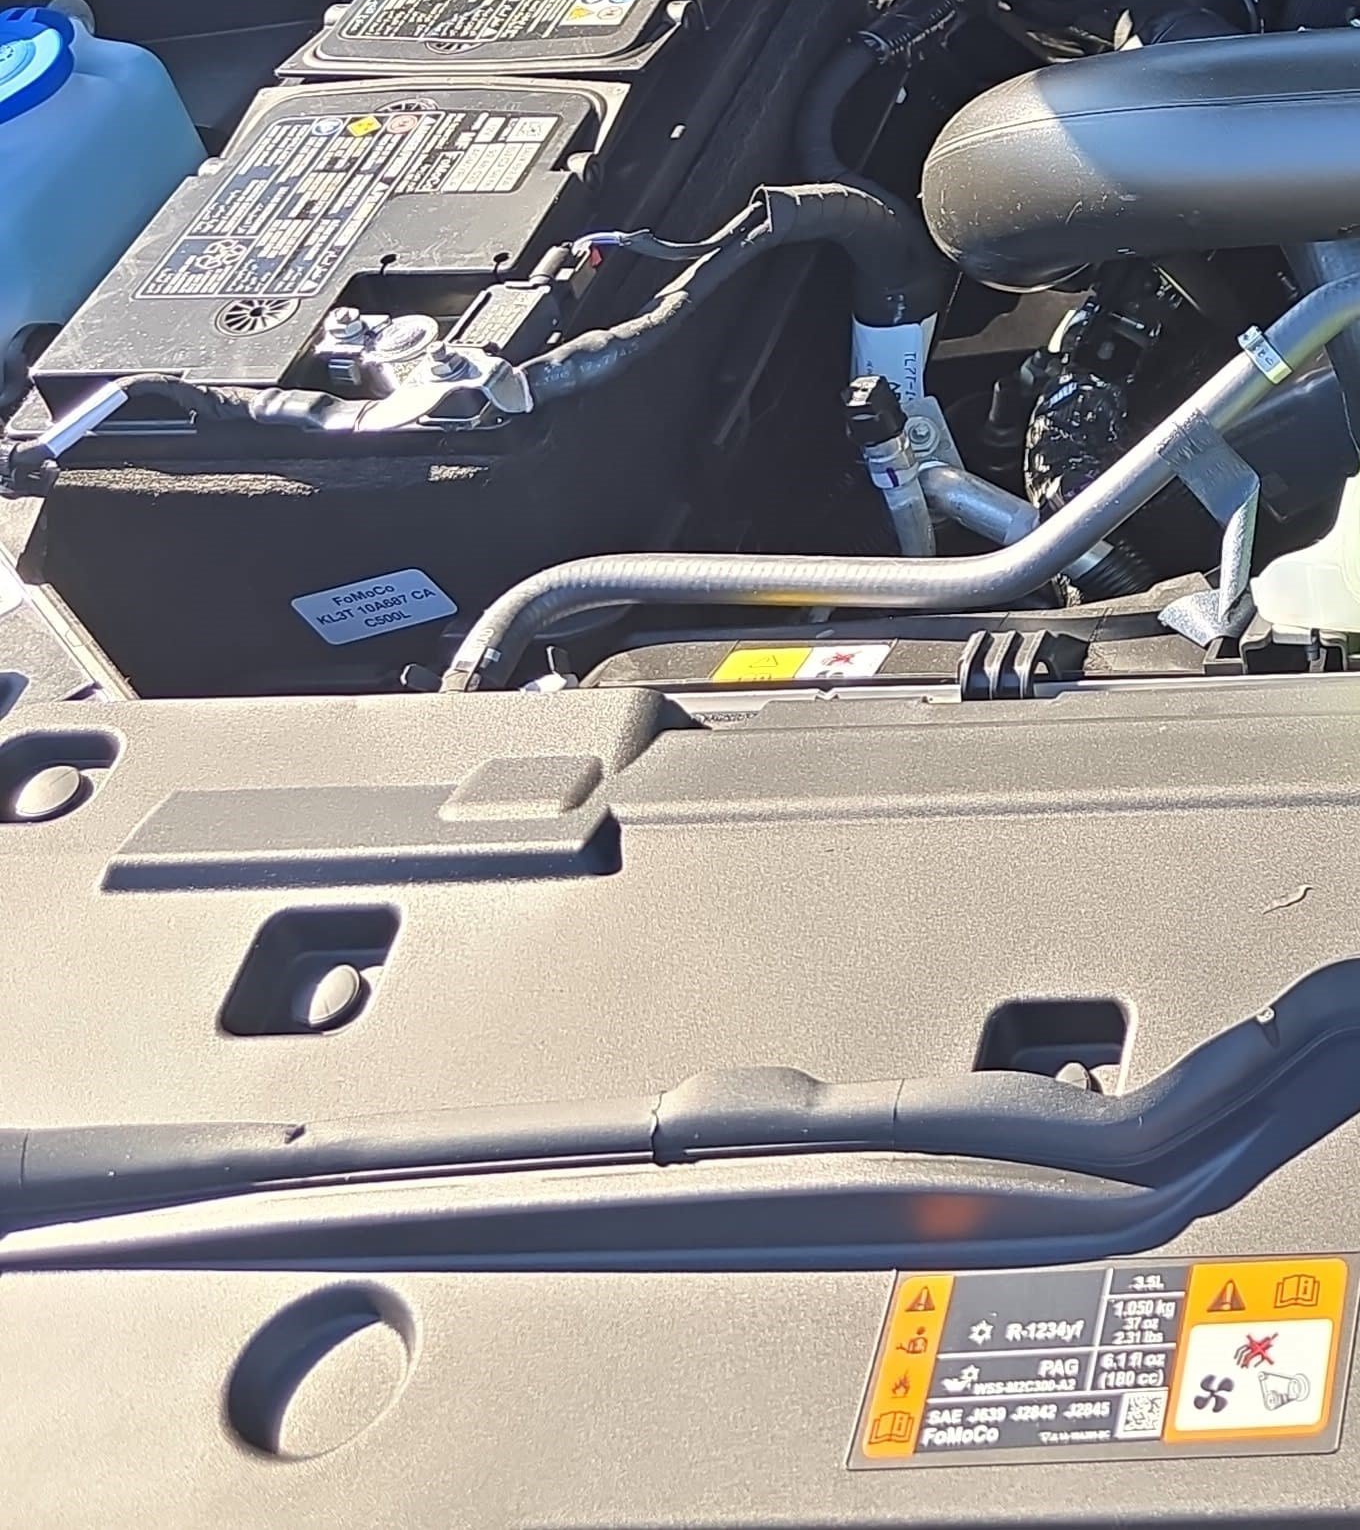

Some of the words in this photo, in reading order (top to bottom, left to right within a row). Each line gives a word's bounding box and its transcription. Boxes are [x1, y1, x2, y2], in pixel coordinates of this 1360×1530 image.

[331, 583, 395, 607] FoMoCo
[316, 607, 355, 627] KL3T
[357, 594, 408, 615] 10A687
[411, 587, 437, 601] CA
[364, 610, 412, 629] C500L
[1112, 1299, 1154, 1318] 1.050
[1155, 1298, 1176, 1320] kg
[1004, 1319, 1085, 1343] R-1234yf
[1122, 1316, 1142, 1330] 37
[1141, 1317, 1160, 1330] oz
[1111, 1330, 1141, 1345] 2.31
[1142, 1330, 1164, 1344] lbs
[1036, 1358, 1080, 1378] PAG
[1100, 1351, 1127, 1370] 6.1
[1128, 1350, 1143, 1369] fl
[1143, 1353, 1166, 1368] oz
[1097, 1369, 1136, 1390] (180
[1136, 1367, 1165, 1387] cc)
[926, 1408, 964, 1426] SAE
[966, 1406, 1007, 1423] J639
[1010, 1404, 1058, 1422] J2842
[1062, 1401, 1112, 1420] J2845
[922, 1424, 1000, 1448] FoMoCo
